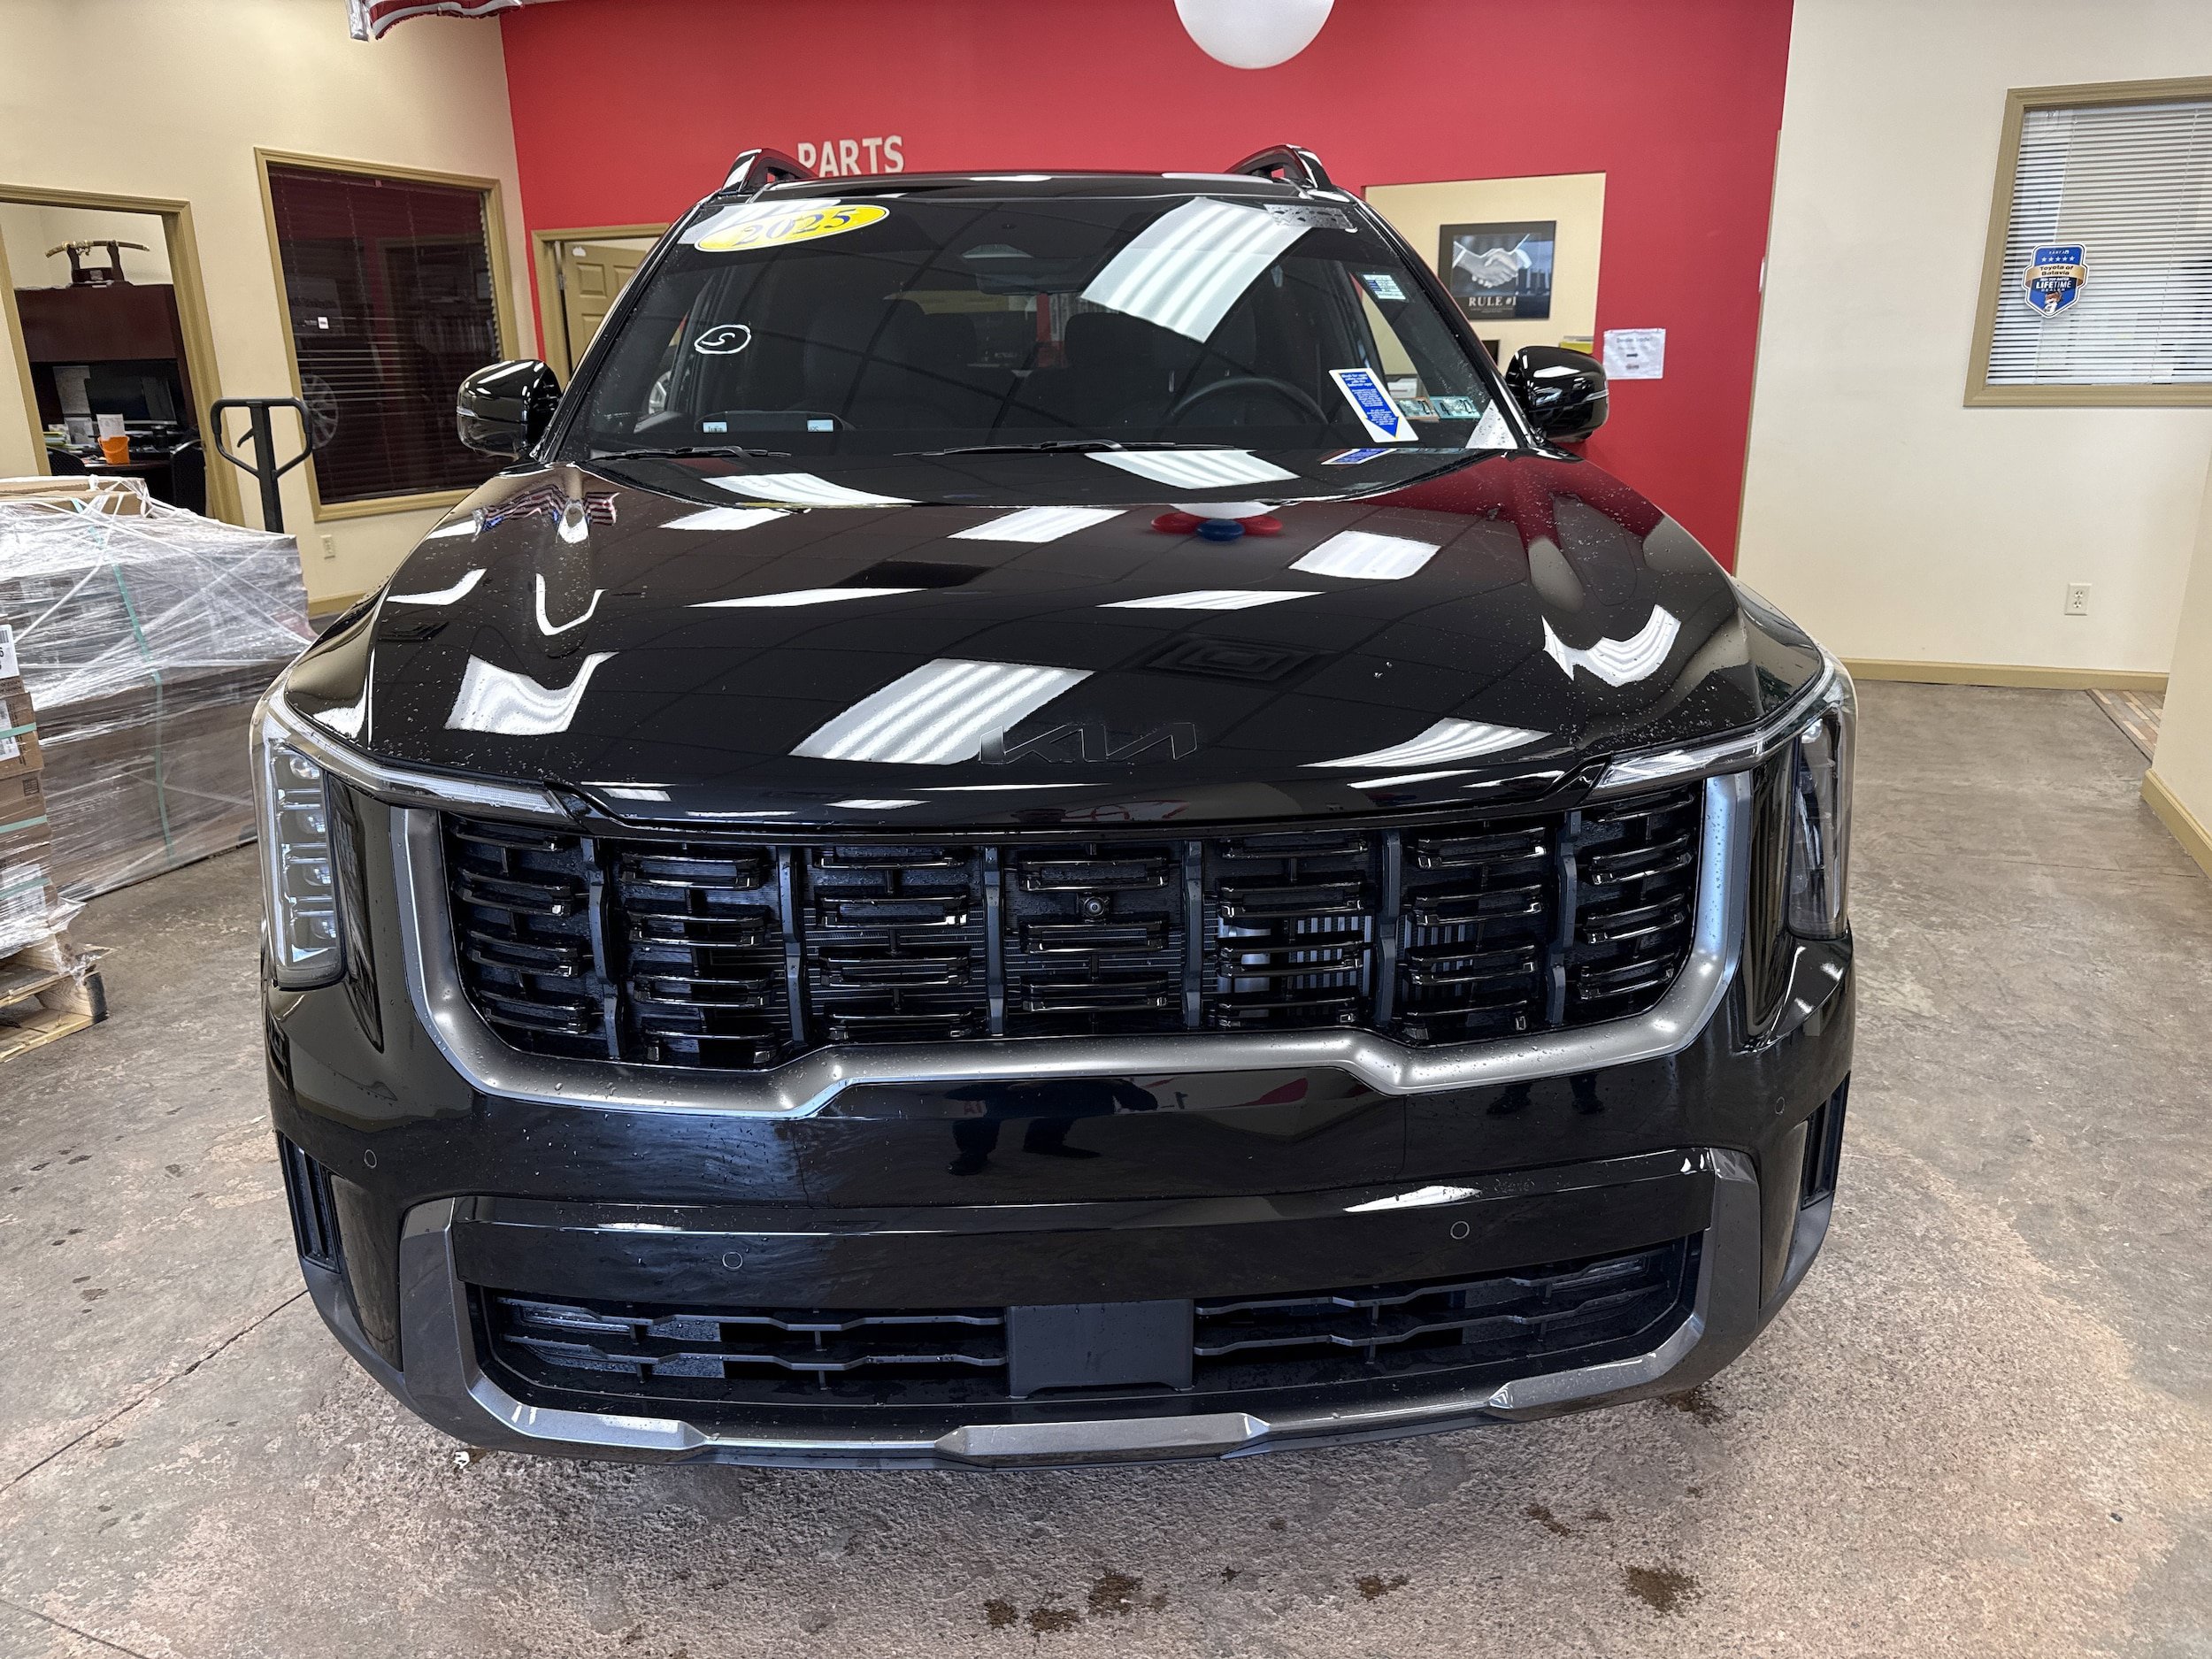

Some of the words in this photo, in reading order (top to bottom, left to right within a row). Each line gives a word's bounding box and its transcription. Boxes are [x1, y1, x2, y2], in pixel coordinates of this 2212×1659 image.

[797, 134, 905, 177] PARTS
[733, 208, 857, 246] 2025
[1468, 296, 1503, 307] RULE
[1505, 296, 1517, 306] #1
[979, 722, 1198, 764] KIA
